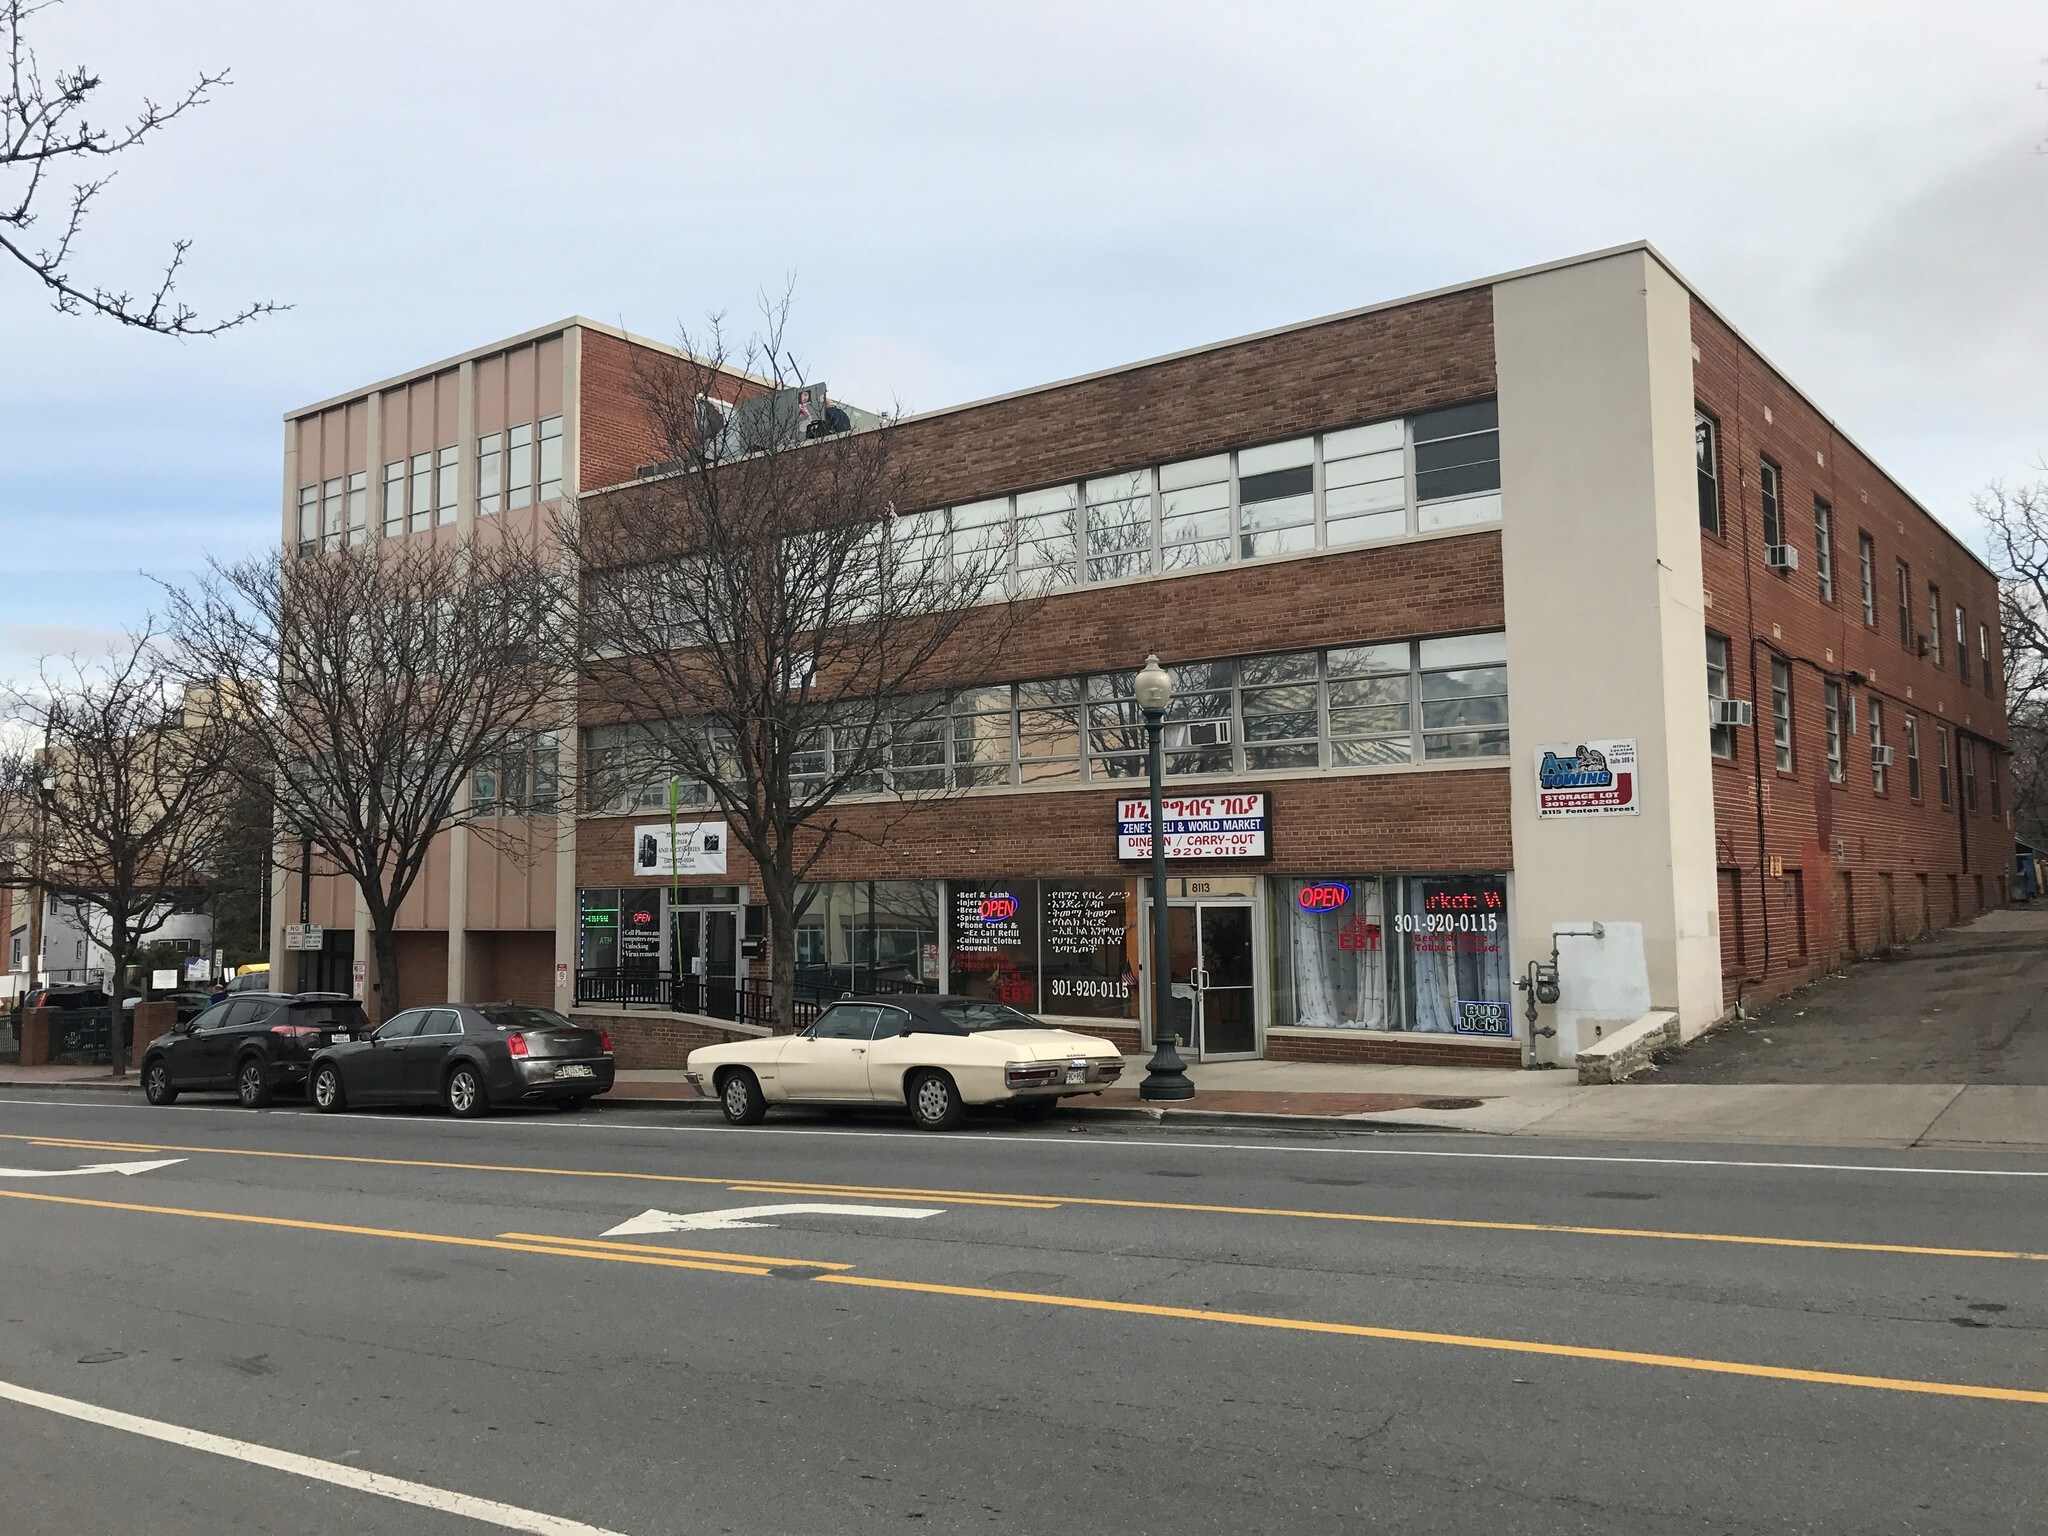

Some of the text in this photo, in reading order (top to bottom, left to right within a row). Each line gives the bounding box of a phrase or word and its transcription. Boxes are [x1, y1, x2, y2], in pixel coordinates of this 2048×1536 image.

[1543, 772, 1610, 788] TOWING
[1544, 791, 1620, 801] STORAGE LOT
[1545, 798, 1620, 807] 301-847-0200
[1163, 822, 1175, 833] ELI
[1177, 822, 1185, 832] &
[1188, 820, 1220, 832] WORLD
[1222, 819, 1261, 831] MARKET
[1187, 834, 1256, 846] CARRY-OUT
[1192, 883, 1210, 892] 8113
[1300, 887, 1345, 907] OPEN
[981, 900, 1015, 917] OPEN
[633, 913, 652, 922] OPEN
[1394, 913, 1497, 932] 301-920-0115
[599, 936, 612, 944] ATM
[992, 937, 1022, 945] Clothes
[1340, 933, 1380, 949] EBT
[625, 943, 649, 951] Unlocking
[1001, 987, 1032, 1001] EBT
[1052, 979, 1129, 998] 301-920-0115
[1465, 1004, 1501, 1017] BUD
[1459, 1017, 1509, 1032] LIGHT
